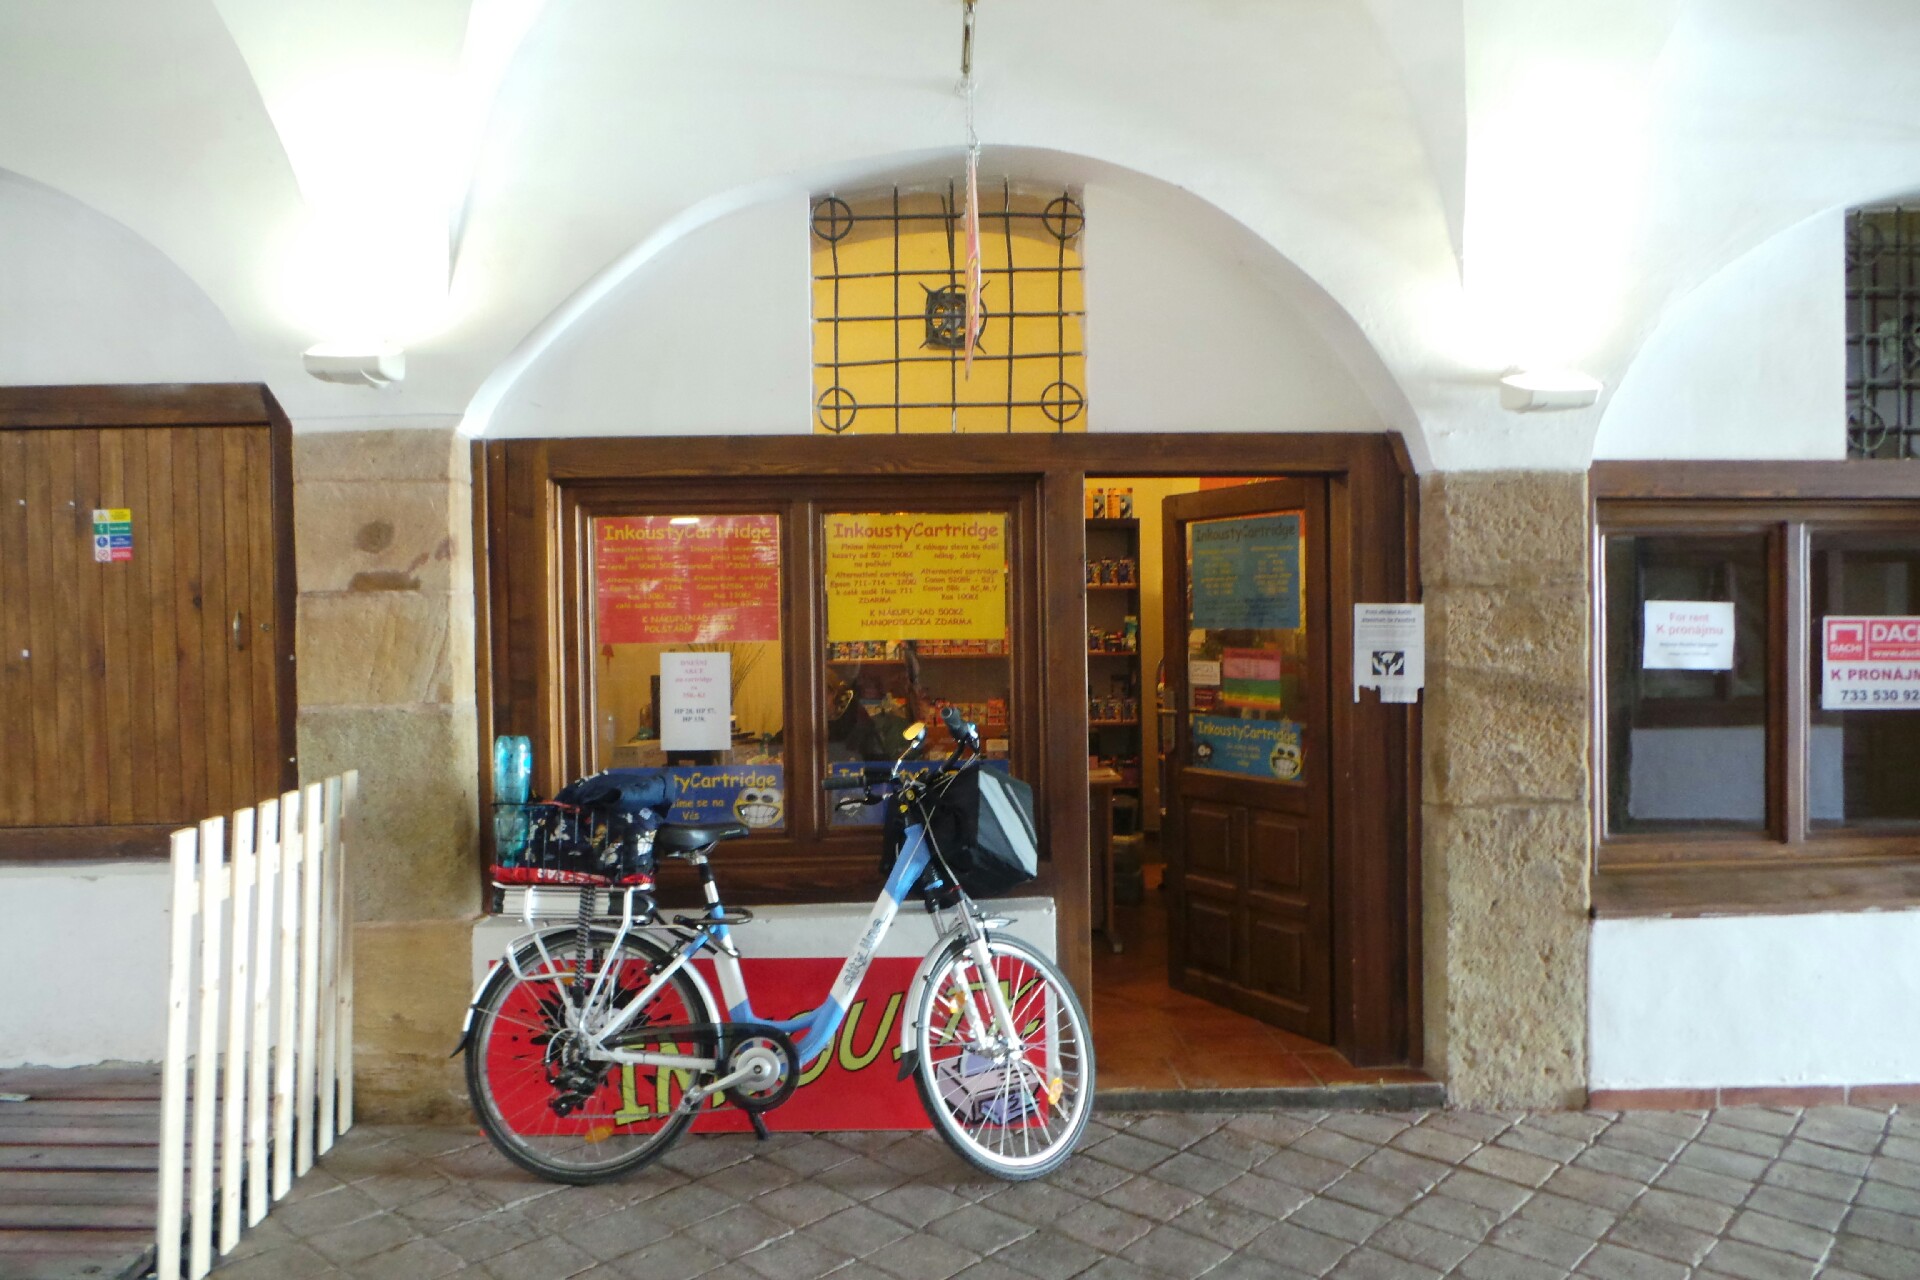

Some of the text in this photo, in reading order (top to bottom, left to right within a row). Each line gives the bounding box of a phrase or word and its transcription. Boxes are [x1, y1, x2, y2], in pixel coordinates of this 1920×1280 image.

[604, 523, 771, 545] InkoustyCartridge
[834, 522, 998, 542] InkoustyCartridge
[1196, 522, 1296, 542] InkoustyCartridge
[1670, 612, 1709, 622] For rent
[1656, 624, 1724, 638] K pronájmu
[1831, 669, 1841, 680] K
[1841, 690, 1868, 701] 733
[1873, 690, 1898, 701] 530
[1198, 720, 1297, 743] InkoustyCartridge
[673, 770, 776, 792] tyCartridge
[614, 978, 1042, 1126] INOUTY
